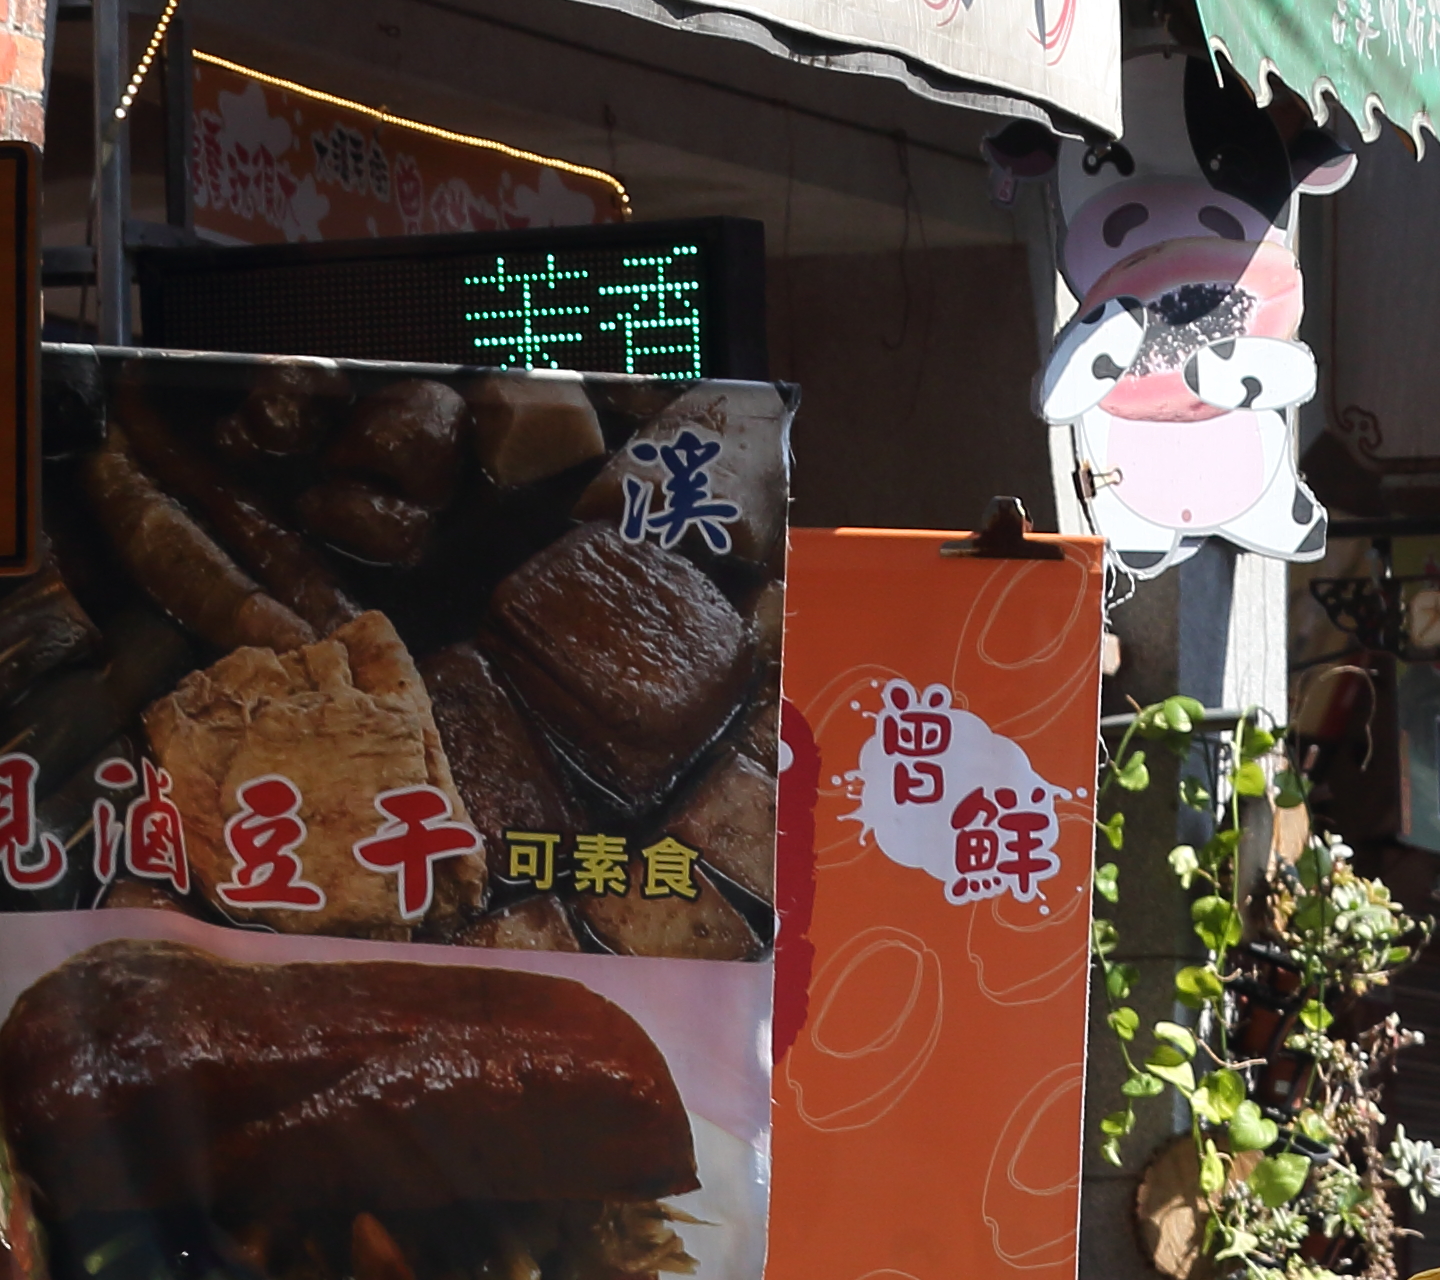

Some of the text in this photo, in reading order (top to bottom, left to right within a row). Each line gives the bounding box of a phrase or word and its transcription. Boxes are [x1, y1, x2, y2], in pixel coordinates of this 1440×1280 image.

[620, 428, 741, 555] 溪
[504, 830, 704, 899] 可素食
